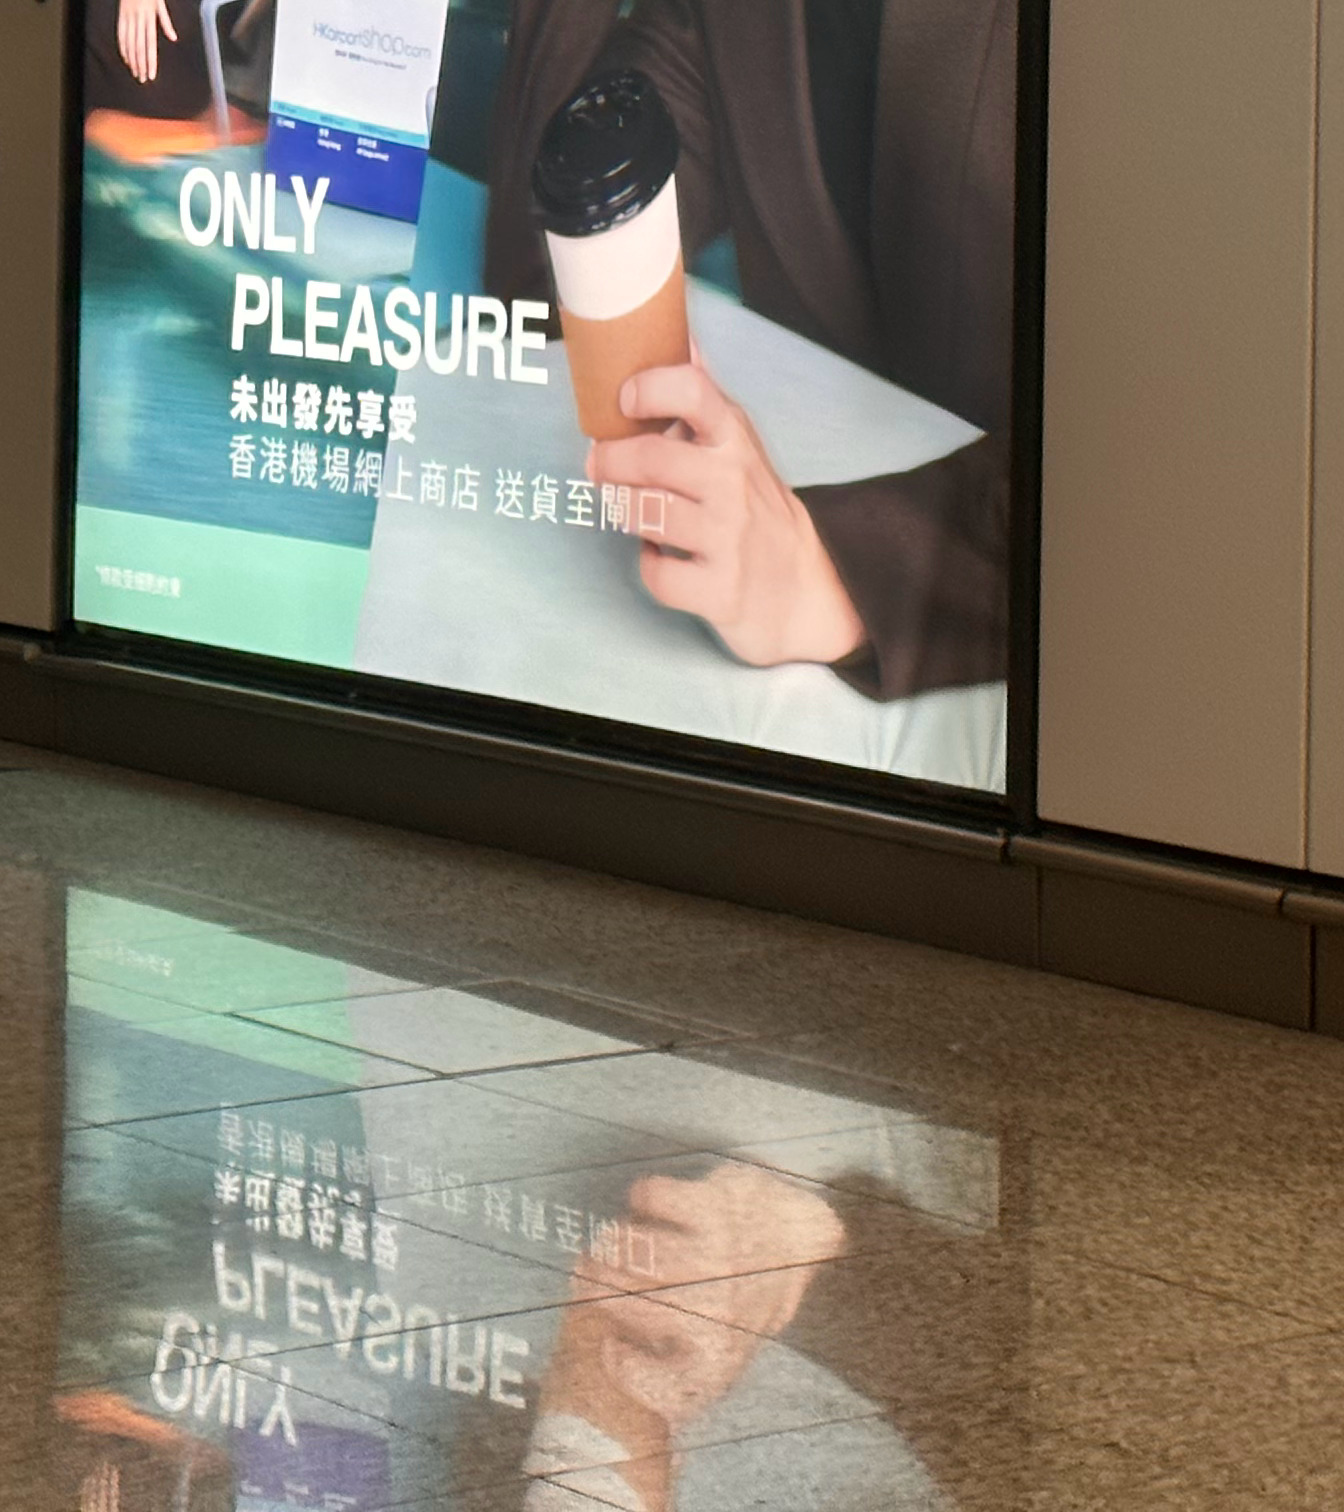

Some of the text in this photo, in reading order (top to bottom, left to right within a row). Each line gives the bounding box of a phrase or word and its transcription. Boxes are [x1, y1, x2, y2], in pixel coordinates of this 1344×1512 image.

[179, 166, 330, 254] ONLY
[230, 273, 550, 385] PLEASURE
[229, 374, 418, 444] 未出發先享受
[228, 434, 481, 512] 香港機場網上商店
